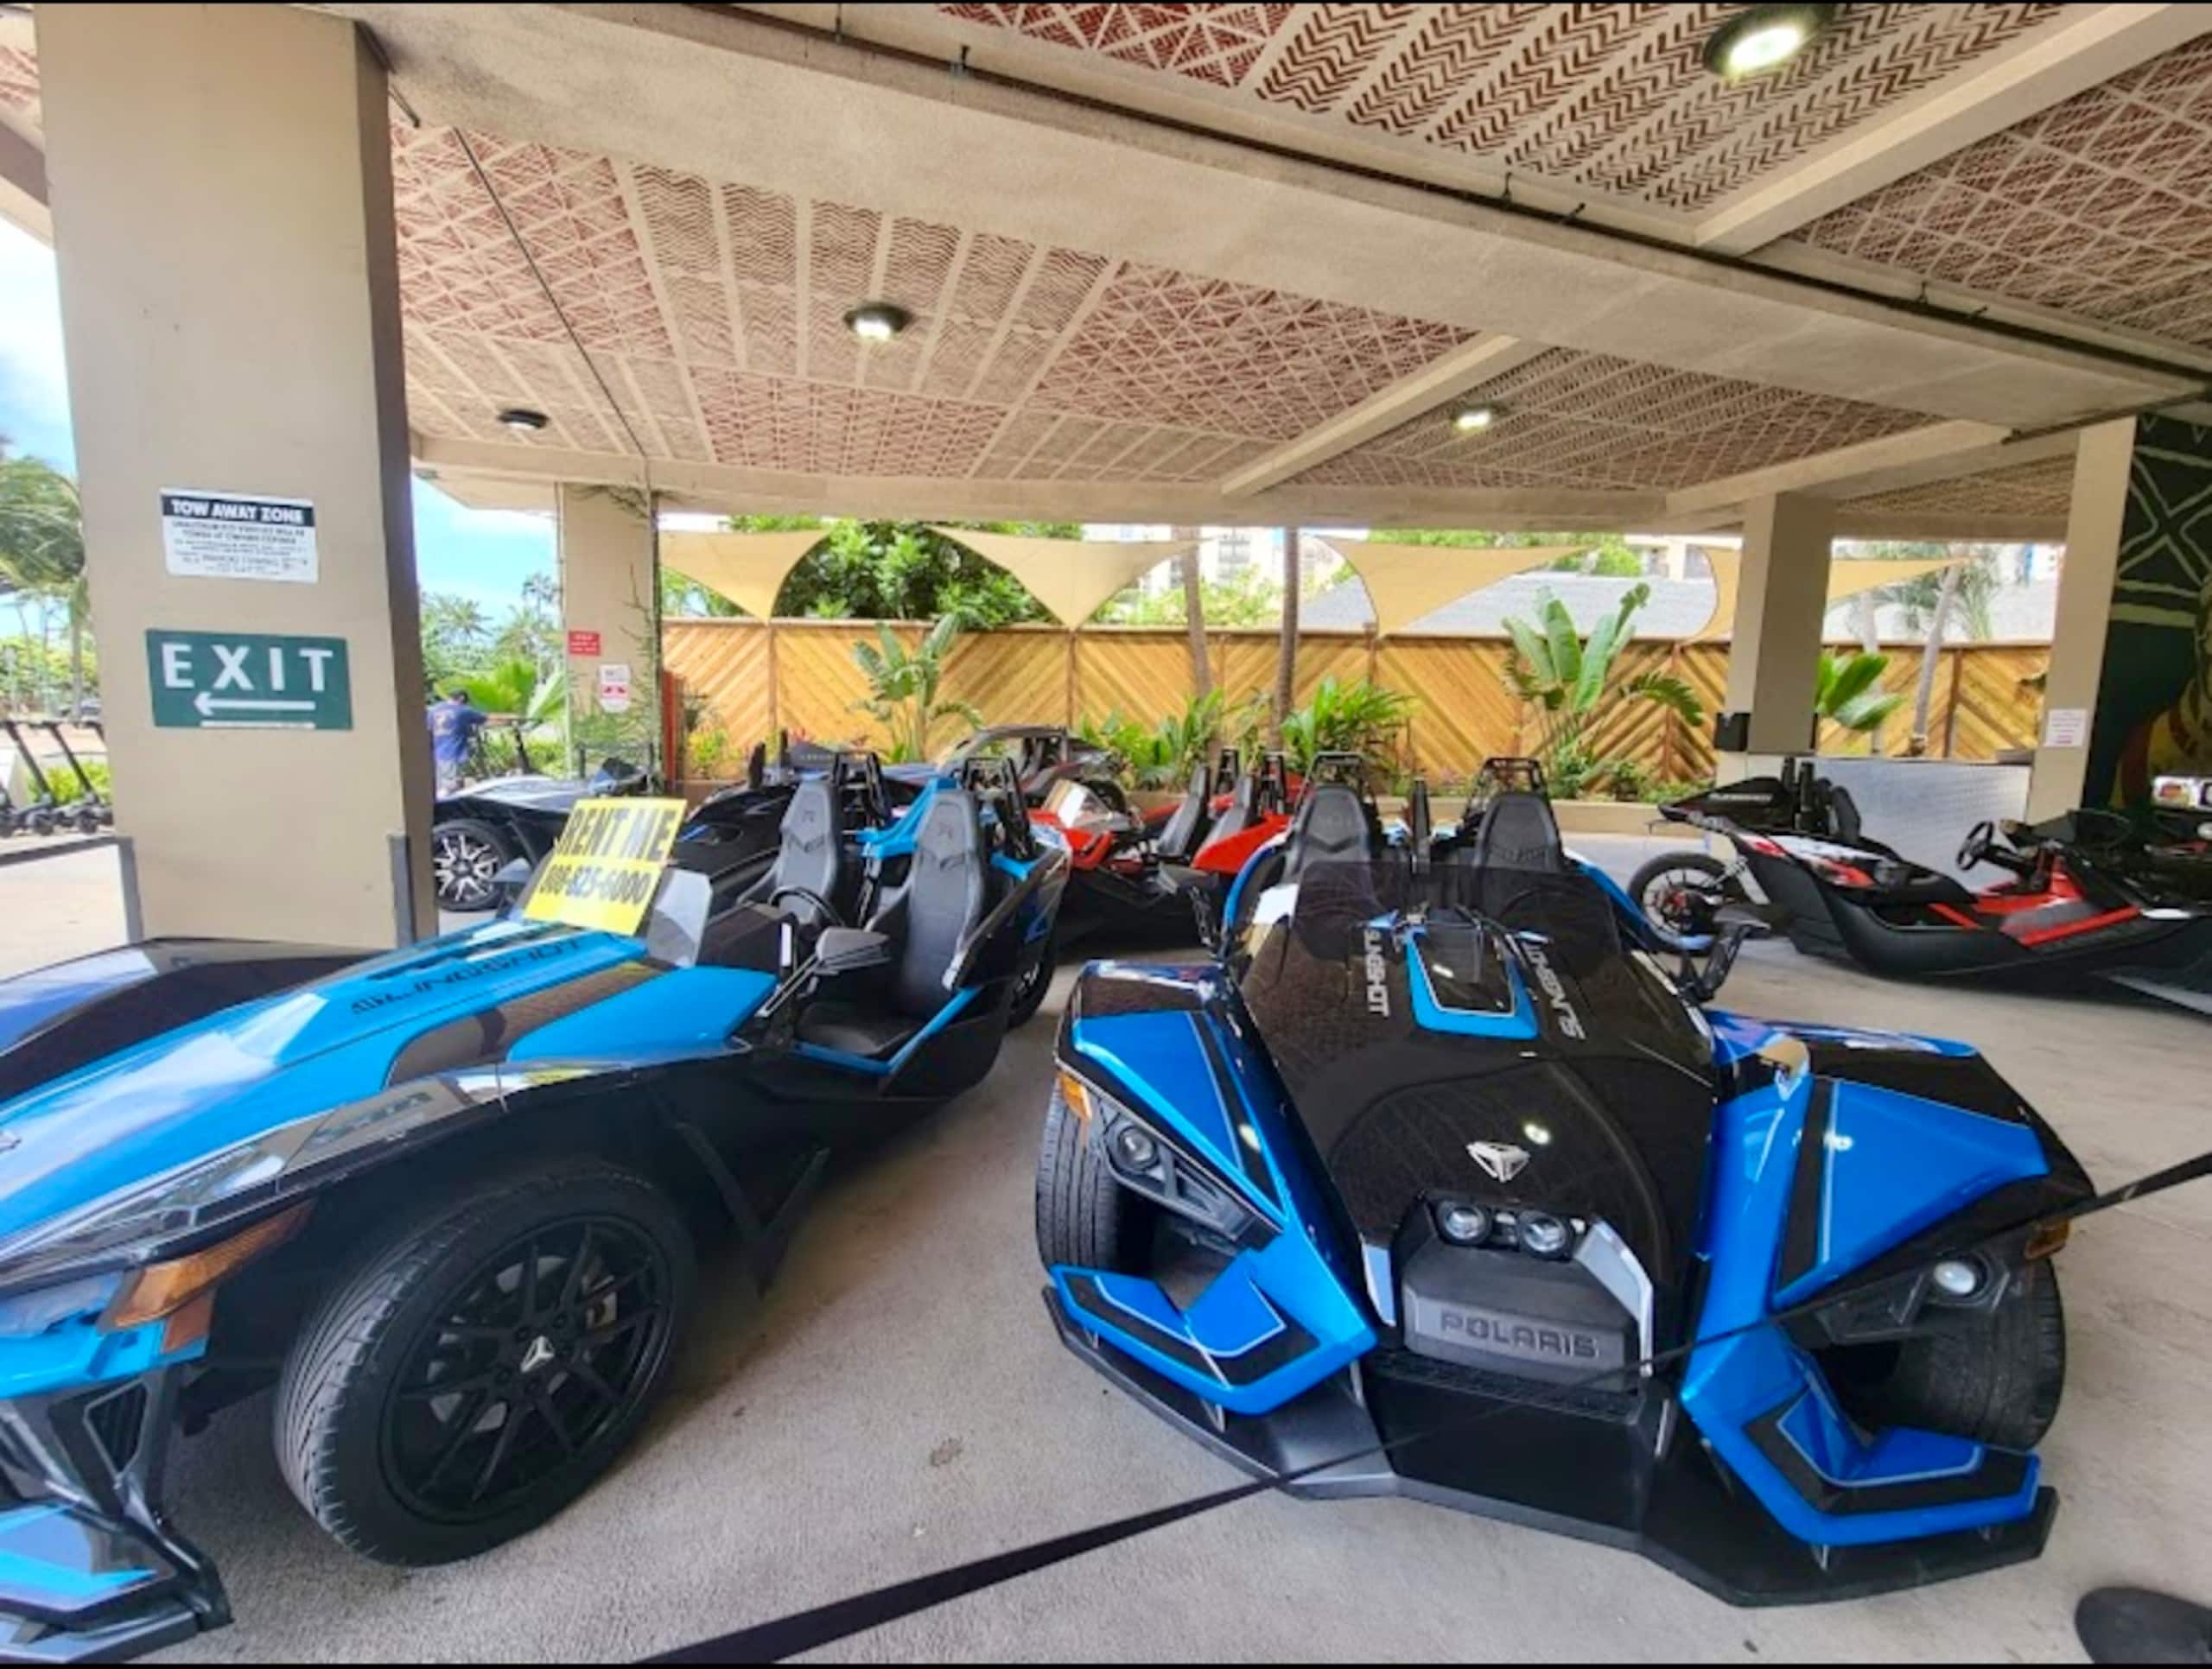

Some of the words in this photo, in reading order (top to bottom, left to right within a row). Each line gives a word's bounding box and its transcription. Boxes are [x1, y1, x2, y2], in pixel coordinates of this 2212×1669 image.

[171, 498, 209, 516] TOW
[211, 503, 257, 520] AWAY
[260, 507, 303, 524] ZONE
[162, 643, 334, 692] EXIT
[557, 807, 631, 857] RENT
[620, 808, 677, 861] ME
[1363, 929, 1390, 1018] SLINGSHOT
[1521, 942, 1587, 1040] SLINGSHOT
[1440, 1310, 1599, 1359] POLARIS
